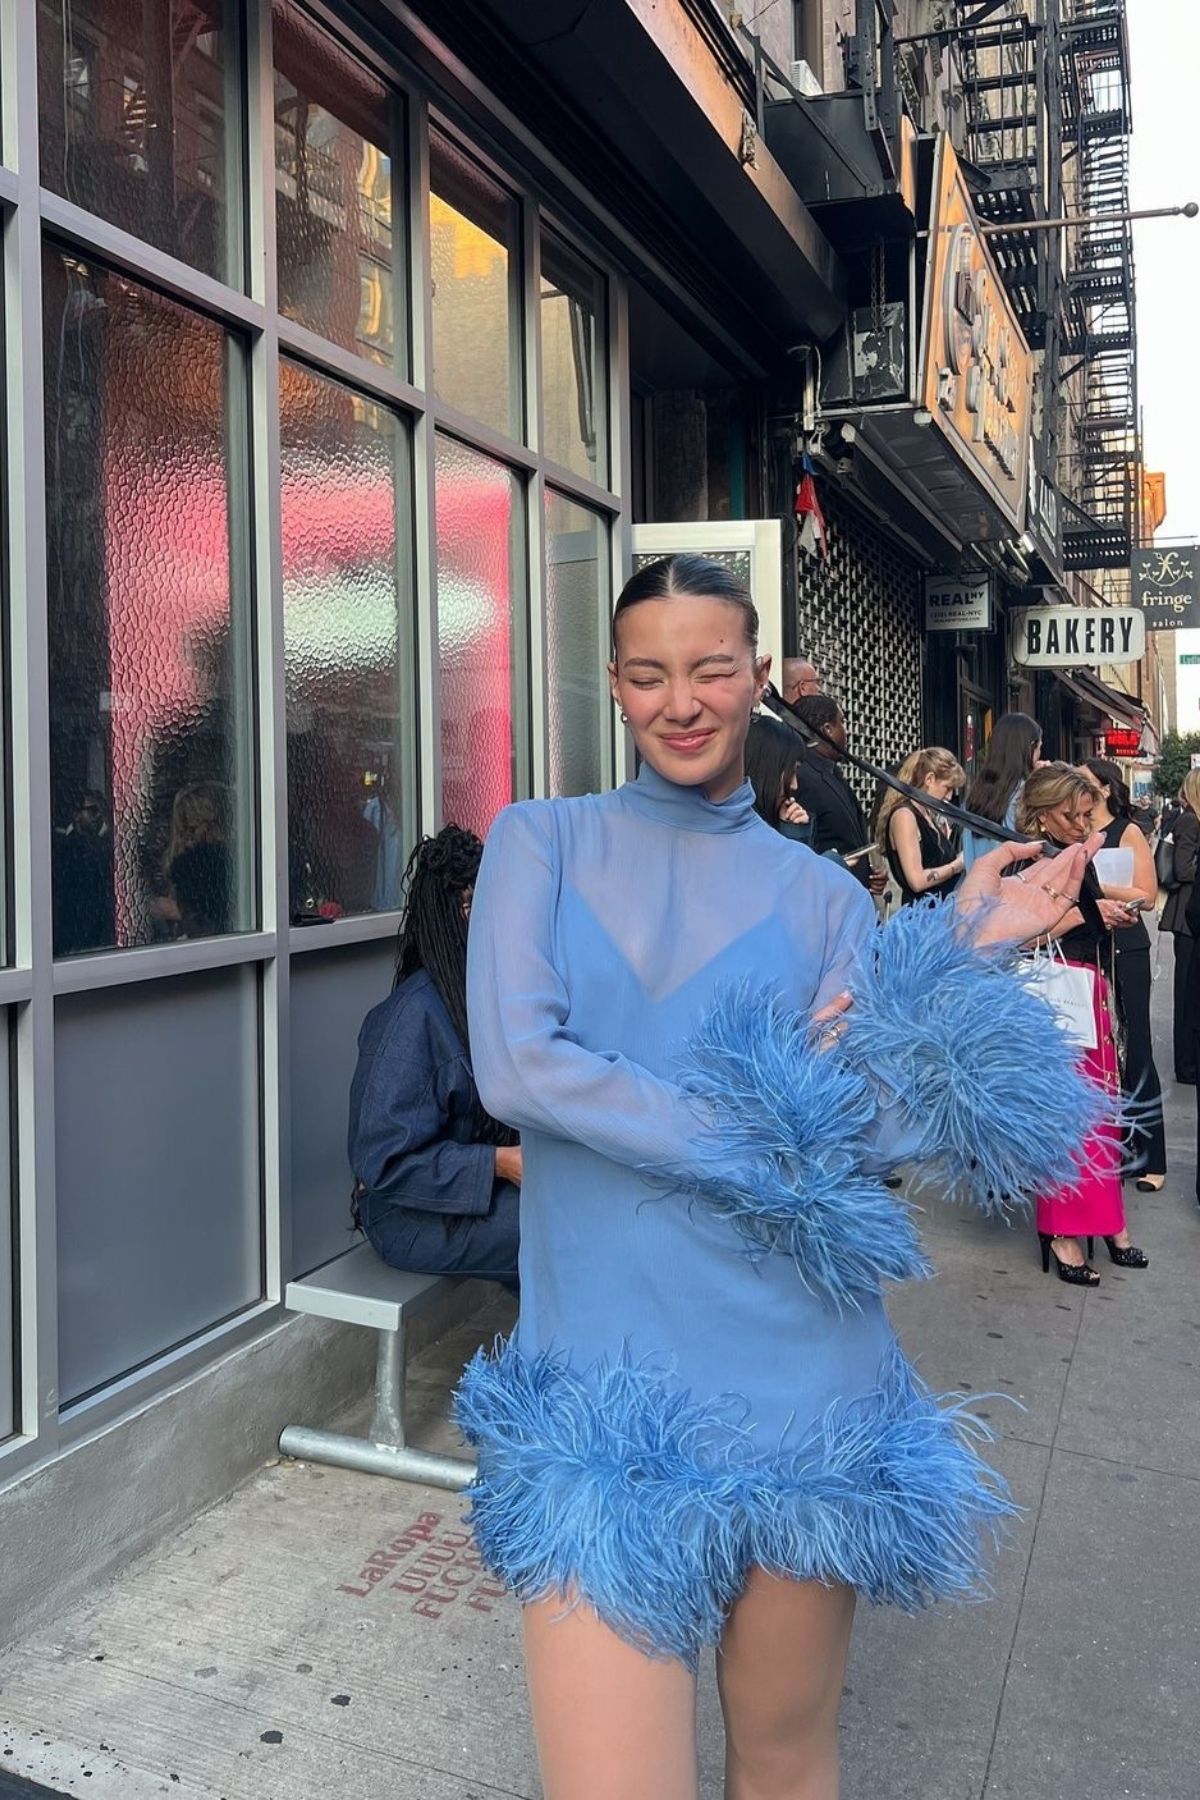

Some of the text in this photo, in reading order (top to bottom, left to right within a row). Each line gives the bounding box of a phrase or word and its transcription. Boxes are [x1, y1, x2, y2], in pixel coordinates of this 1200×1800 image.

[1142, 591, 1192, 613] fringe
[1027, 617, 1133, 654] BAKERY
[1153, 618, 1183, 627] salon
[335, 1511, 443, 1598] LaRopa
[411, 1544, 482, 1619] FUCK
